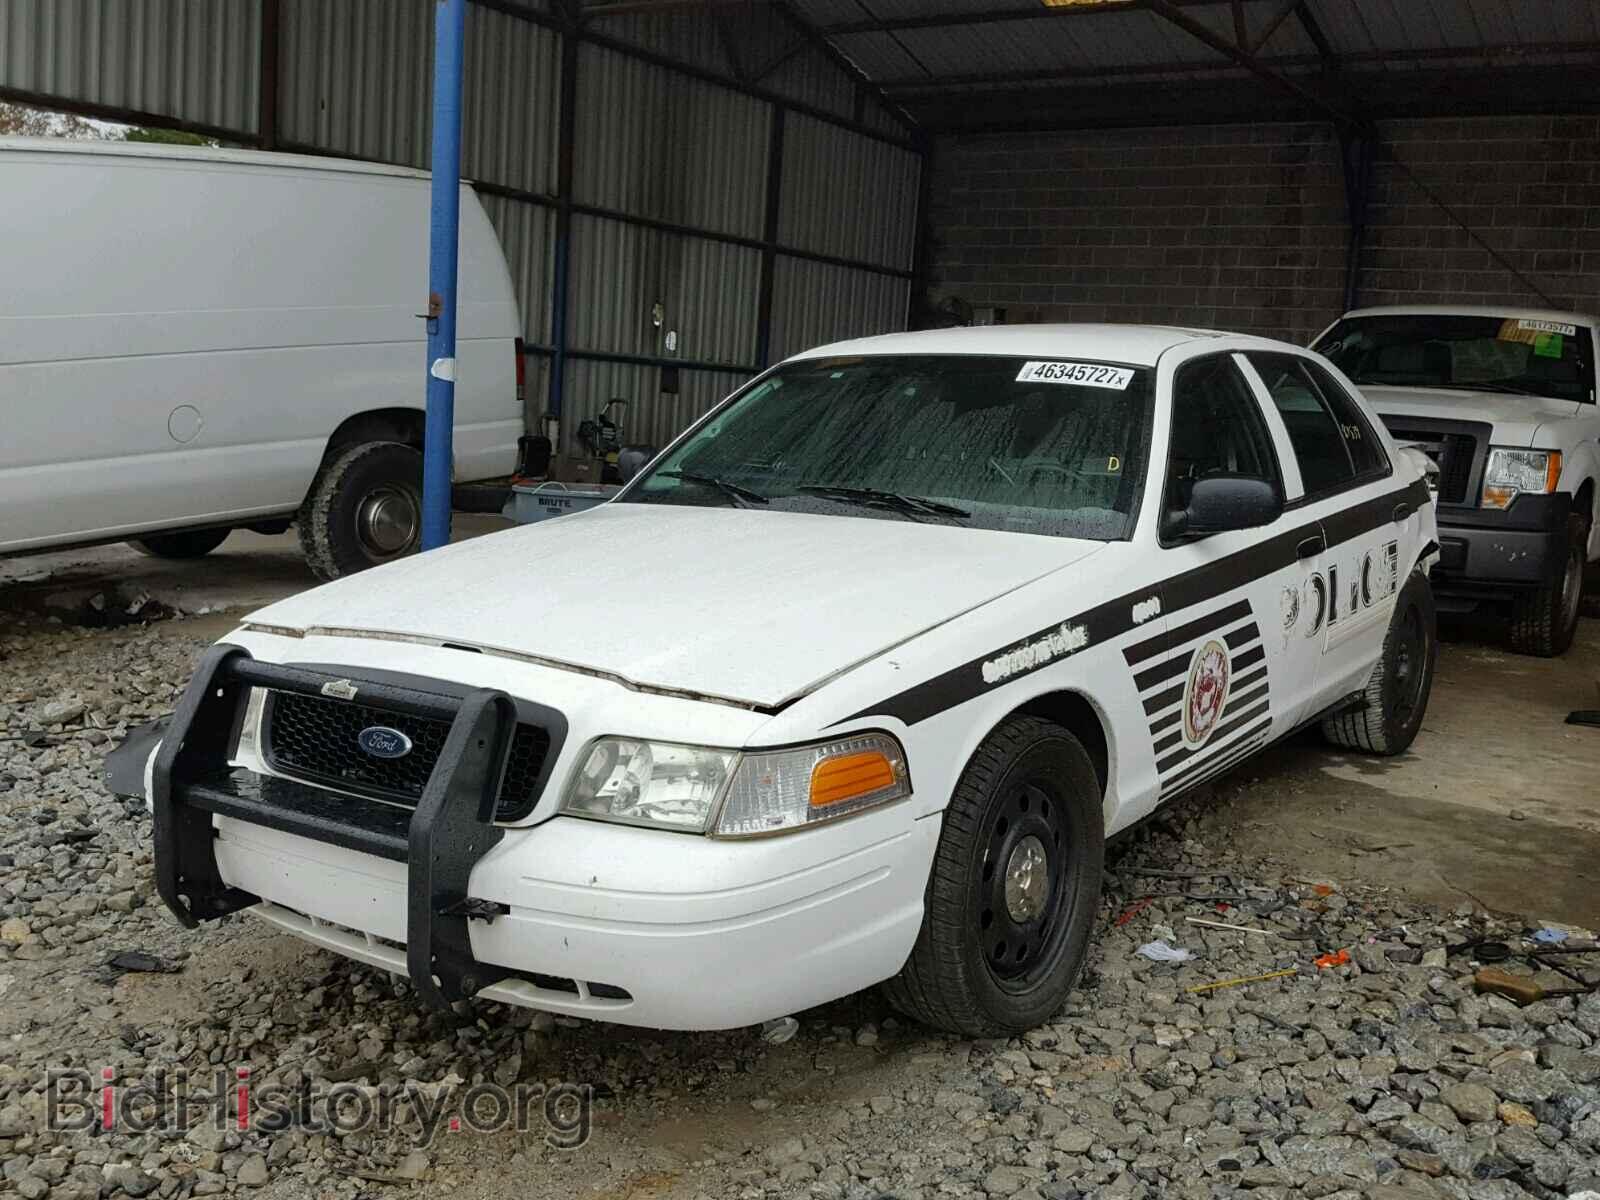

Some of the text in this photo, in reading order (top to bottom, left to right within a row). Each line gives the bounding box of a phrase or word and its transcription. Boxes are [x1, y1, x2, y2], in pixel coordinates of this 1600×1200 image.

[1107, 456, 1120, 472] D
[538, 497, 573, 508] BRUTE
[368, 731, 398, 752] Ford
